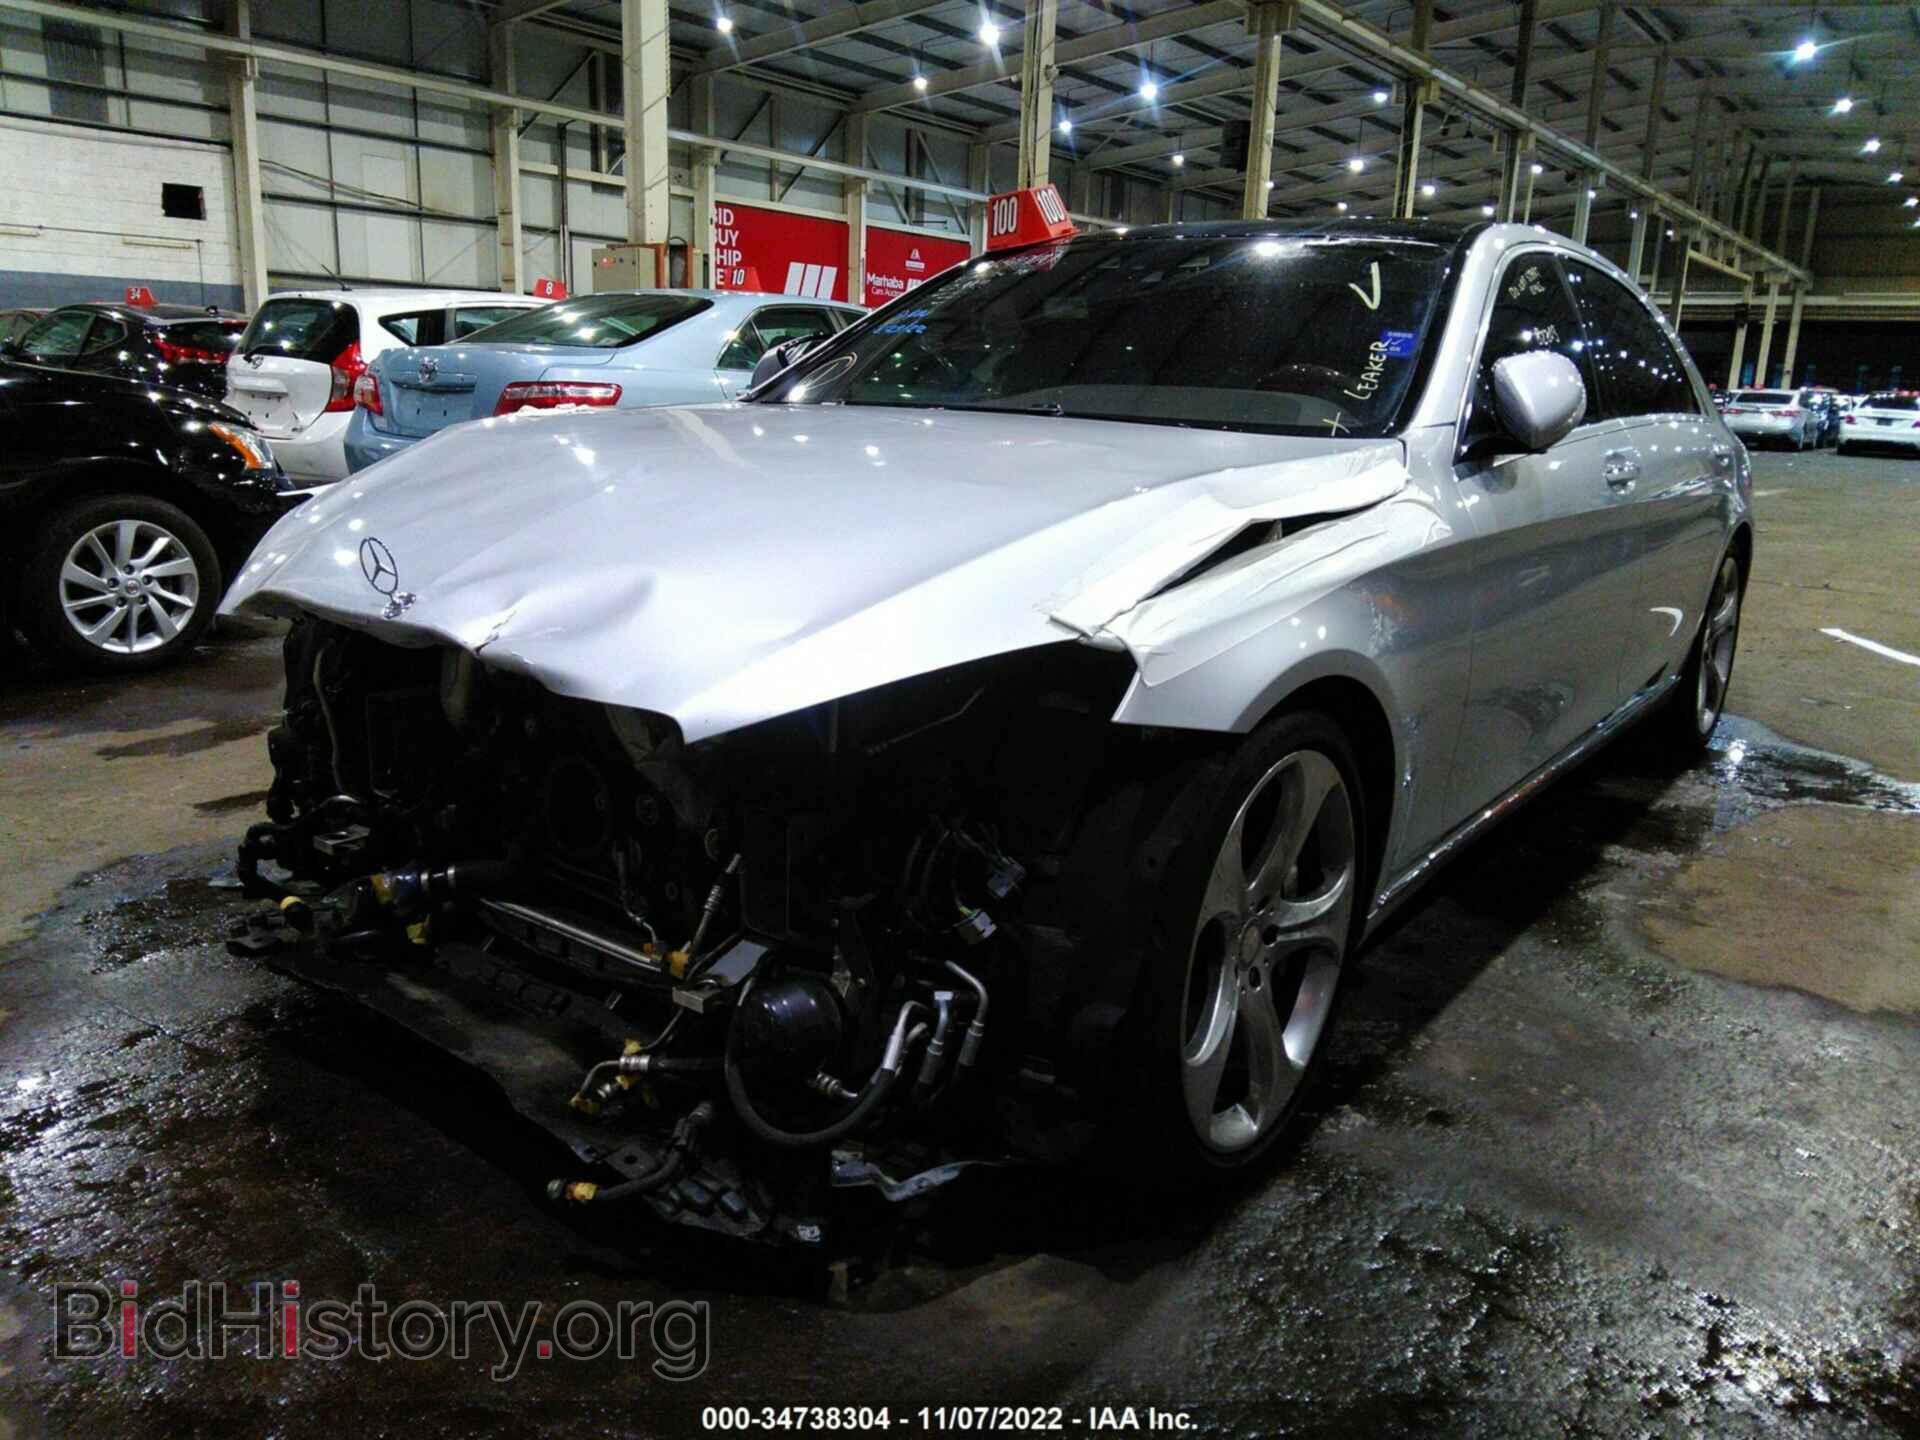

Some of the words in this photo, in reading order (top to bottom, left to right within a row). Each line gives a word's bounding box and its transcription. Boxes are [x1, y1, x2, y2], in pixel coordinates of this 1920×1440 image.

[993, 196, 1018, 237] 100
[732, 268, 745, 286] 10
[866, 271, 904, 290] Marhaba
[546, 280, 553, 296] 8
